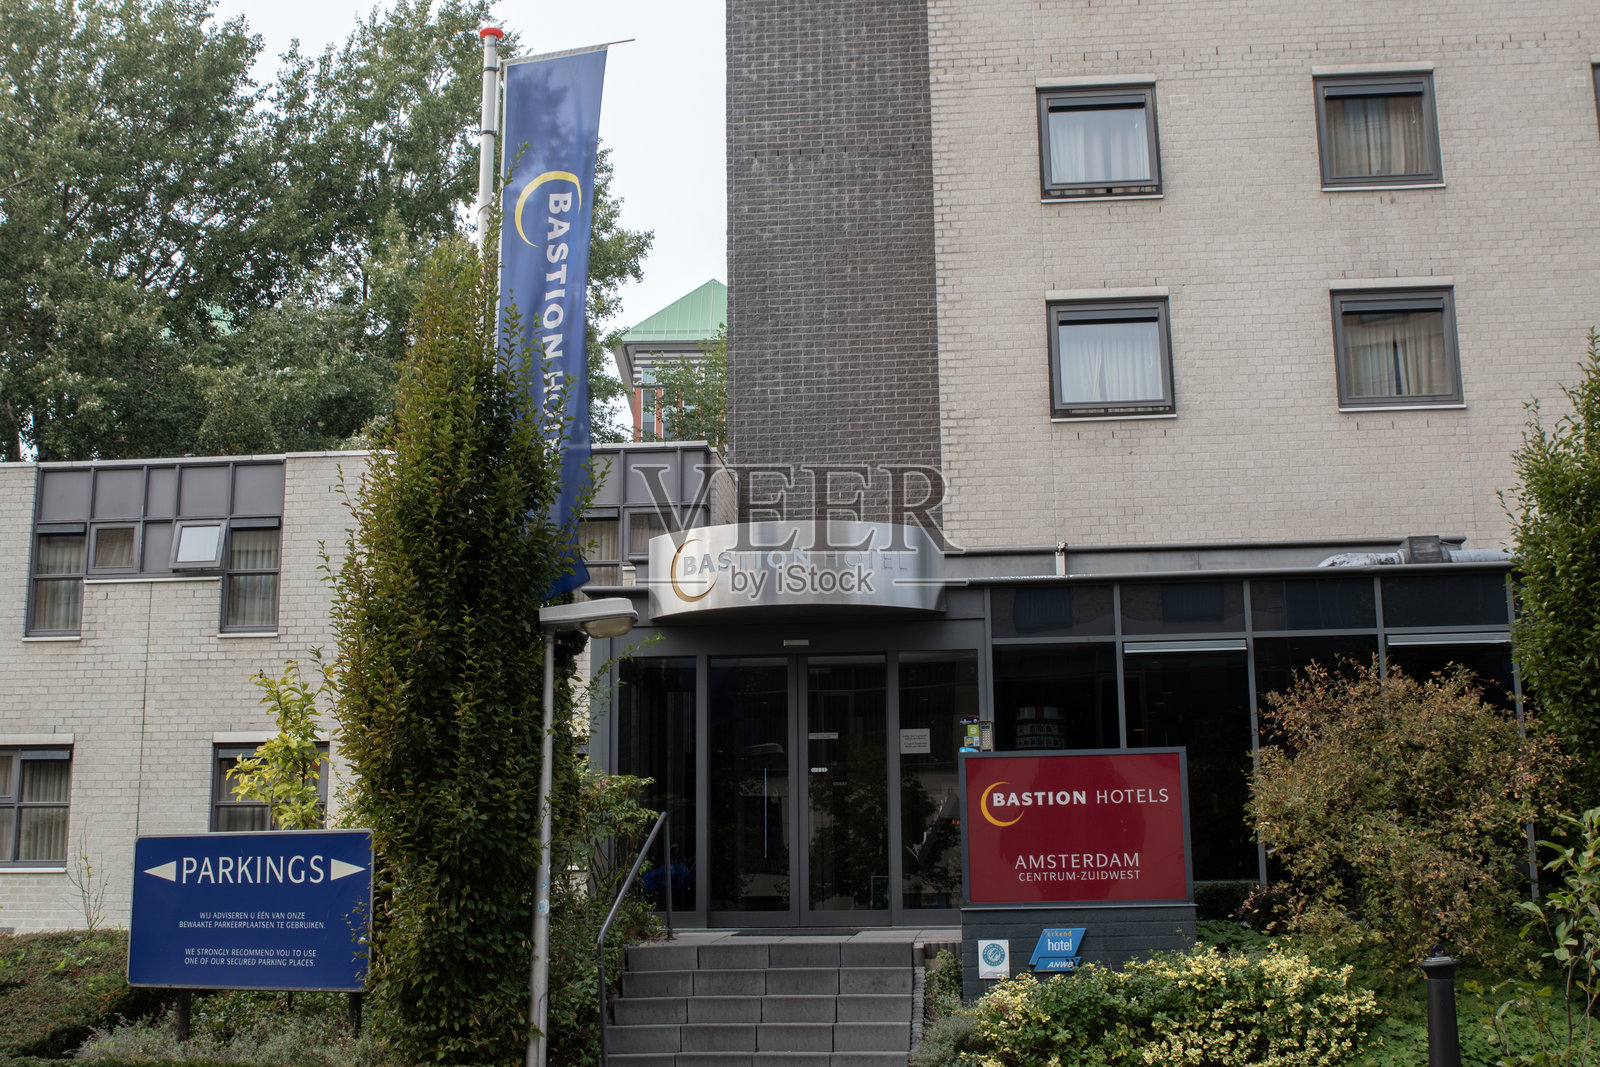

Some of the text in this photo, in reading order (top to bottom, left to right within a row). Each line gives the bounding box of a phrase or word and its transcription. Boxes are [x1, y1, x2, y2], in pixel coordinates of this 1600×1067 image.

[542, 192, 572, 360] BASTION
[683, 548, 908, 577] BASTION HOTEL
[992, 788, 1169, 807] BASTION HOTELS
[1014, 852, 1140, 870] AMSTERDAM
[182, 855, 325, 884] PARKINGS
[1018, 870, 1141, 882] CENTRUM-ZUIDWEST
[199, 911, 212, 919] WIJ
[213, 911, 248, 919] ADVISEREN
[250, 911, 255, 919] U
[271, 911, 285, 919] VAN
[286, 911, 306, 919] ONZE
[179, 920, 327, 930] BEWAAKTE PARKEERPLAATSEN TE GEBRUIKEN.
[1047, 938, 1073, 952] hotel
[185, 948, 317, 957] WE STRONGLY RECOMMEND YOU TO USE
[184, 957, 316, 967] ONE OF OUR SECURED PARKING PLACES.
[1047, 961, 1074, 969] ANWB
